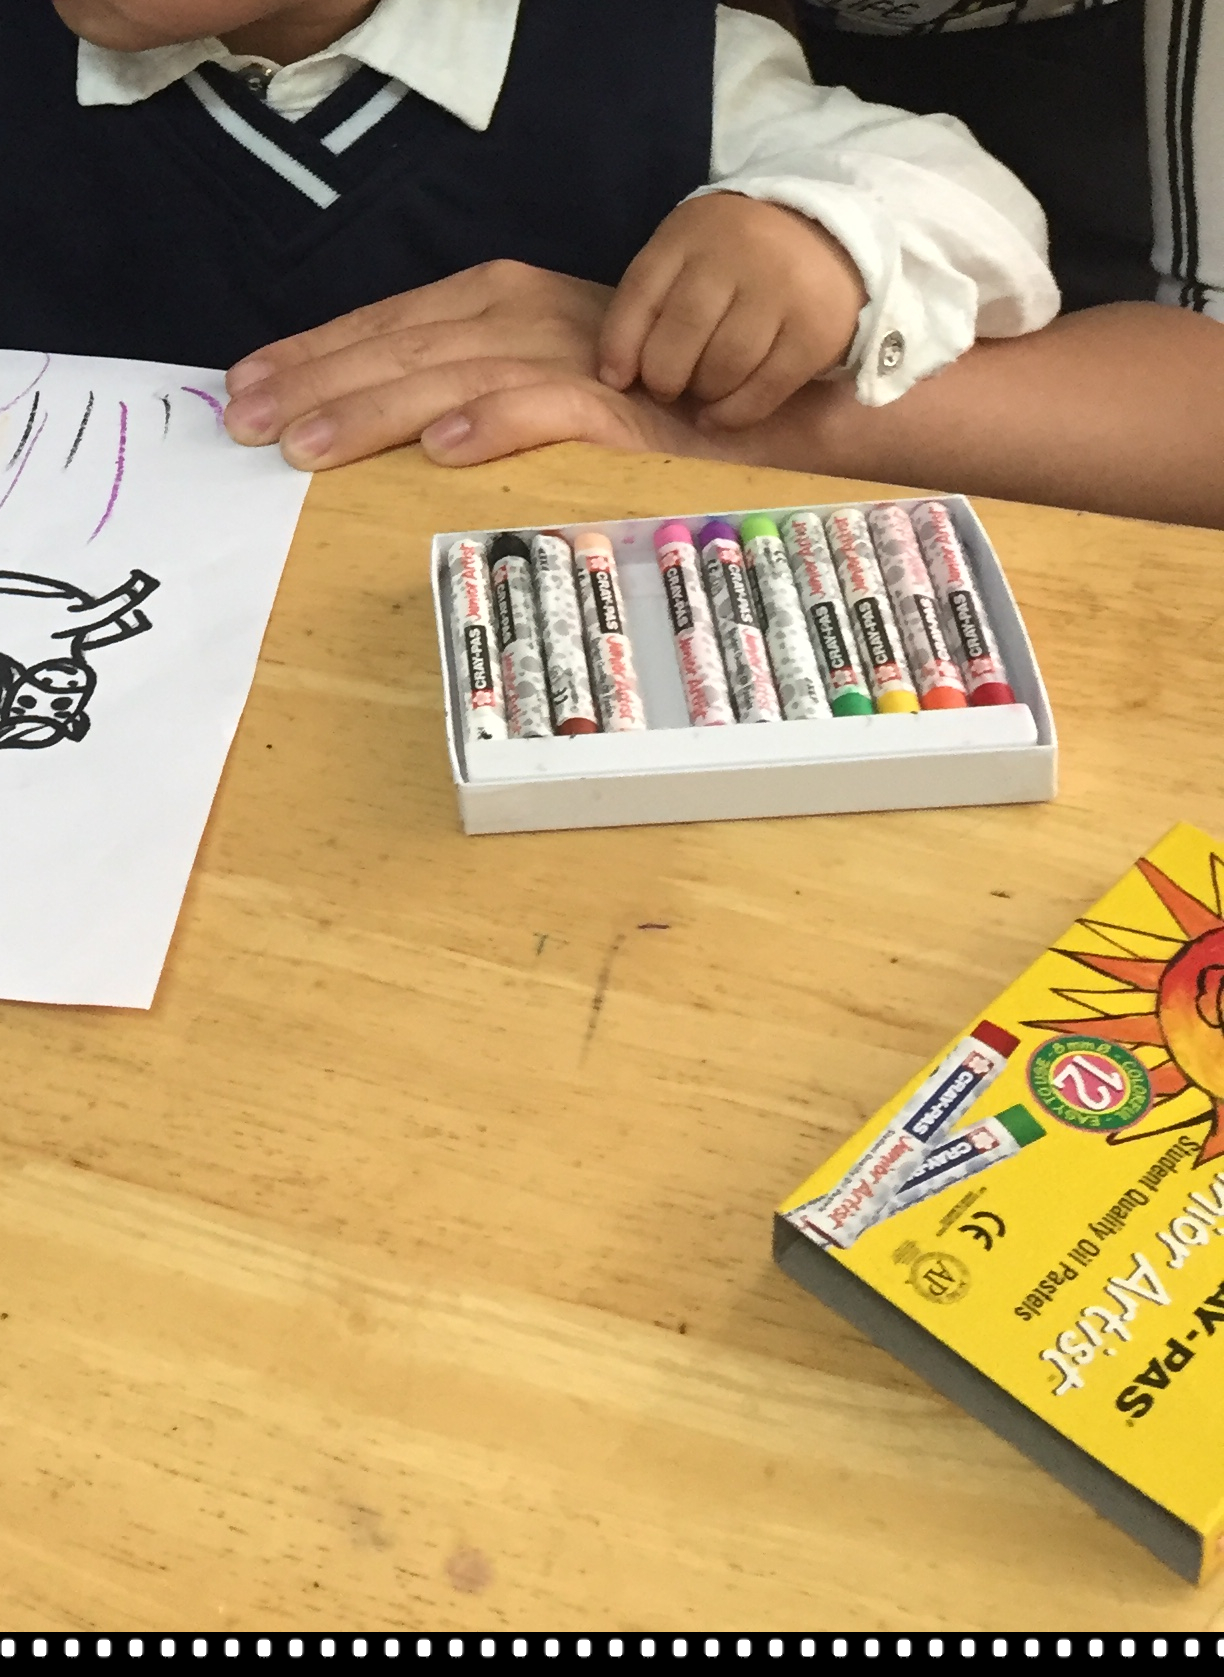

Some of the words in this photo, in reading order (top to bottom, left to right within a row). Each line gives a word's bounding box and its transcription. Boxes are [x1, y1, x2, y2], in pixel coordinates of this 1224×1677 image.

[595, 571, 620, 631] CRAY-PAS
[956, 594, 983, 658] CRAY-PAS
[468, 627, 488, 689] CRAY-PAS
[815, 605, 845, 669] CRAY-PAS
[858, 601, 888, 664] CRAY-PAS
[912, 1070, 975, 1136] CRAY-PAS
[1052, 1054, 1124, 1111] 12
[1138, 1134, 1202, 1193] Student
[1087, 1187, 1151, 1242] Quality
[1154, 1171, 1224, 1270] nior
[1067, 1237, 1101, 1268] Oil
[1014, 1260, 1080, 1322] Pastels
[1039, 1251, 1173, 1397] Artist
[1114, 1279, 1224, 1420] AY-PAS
